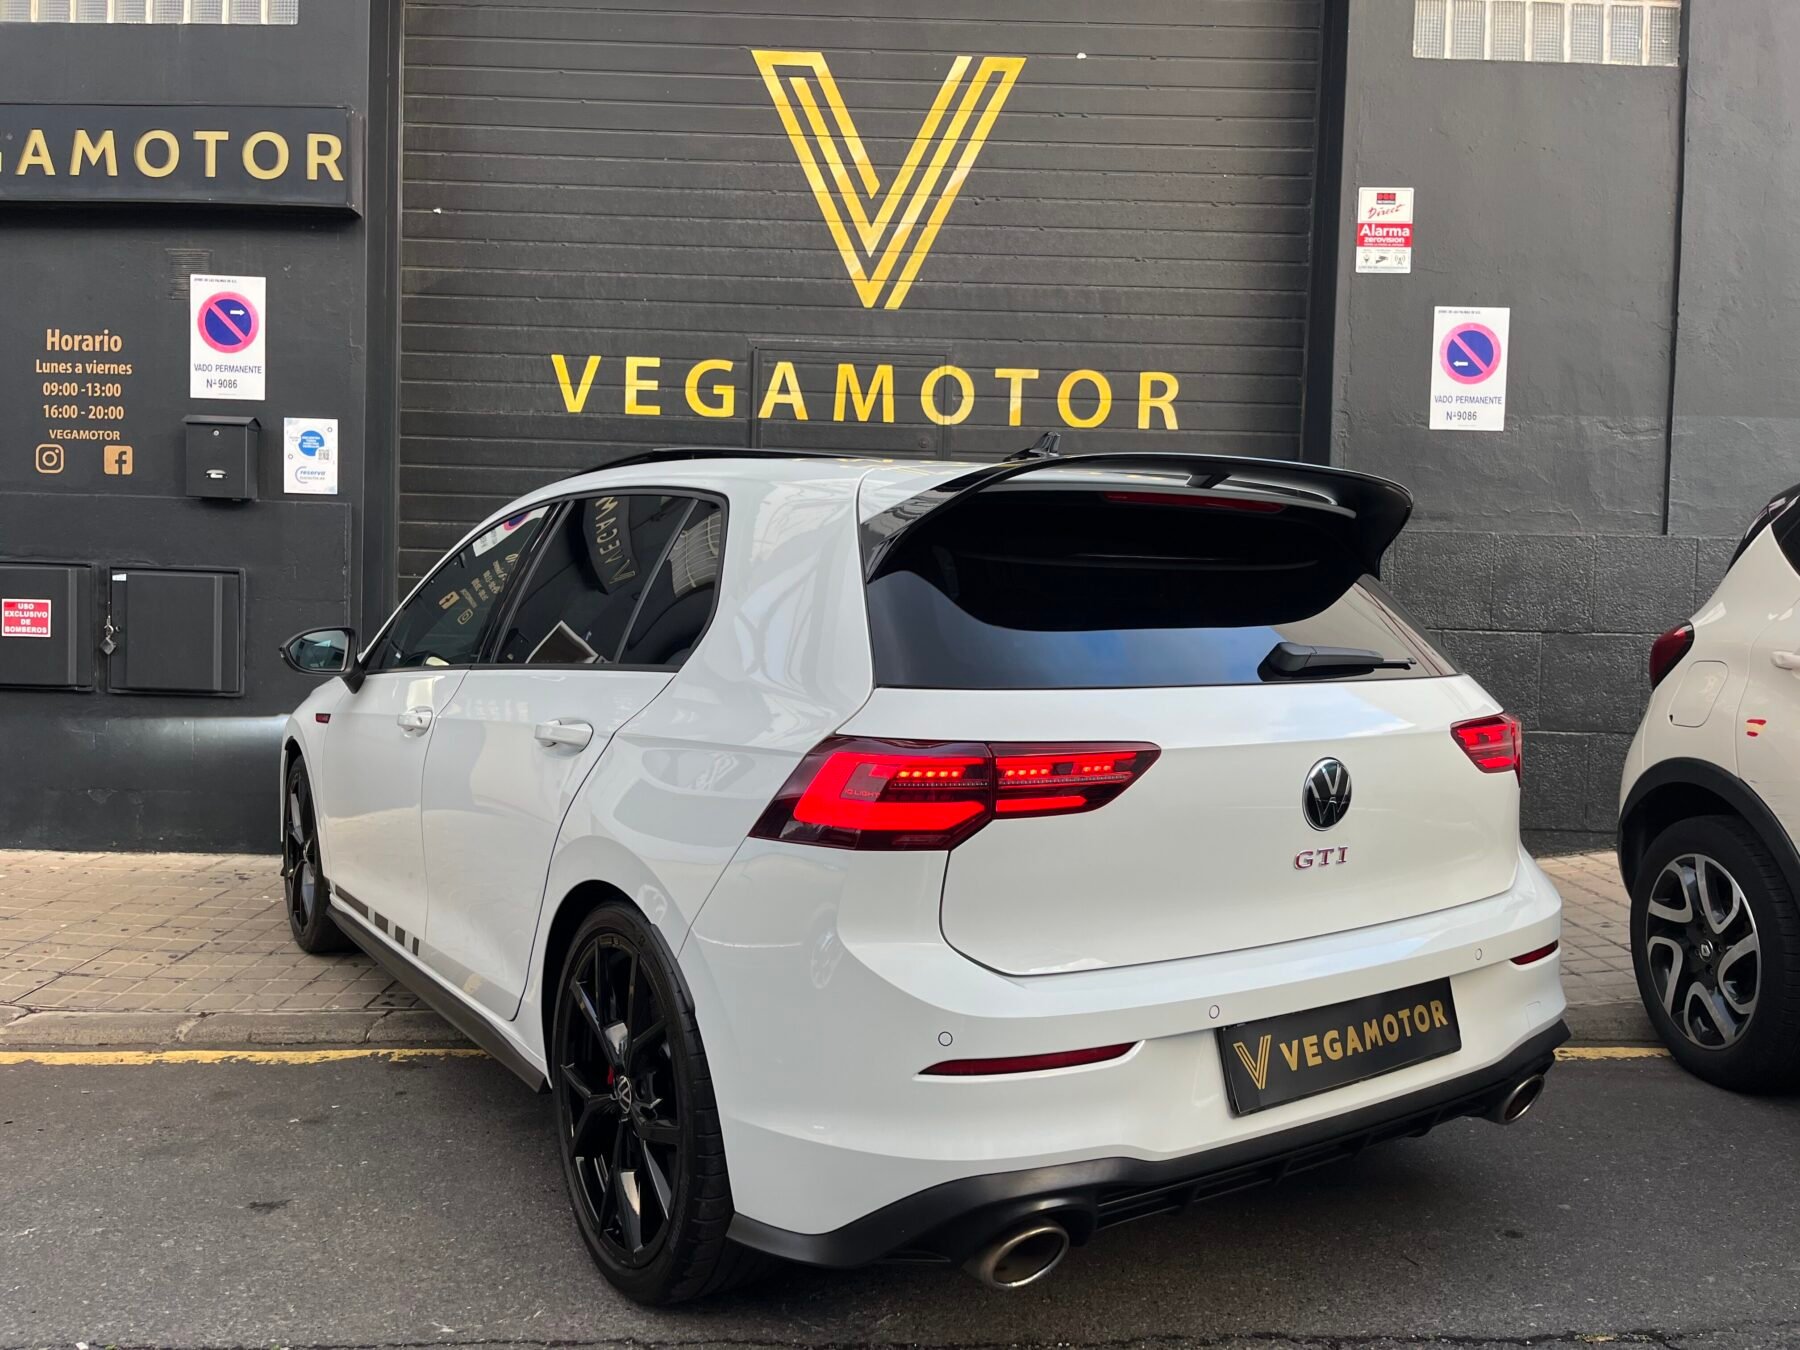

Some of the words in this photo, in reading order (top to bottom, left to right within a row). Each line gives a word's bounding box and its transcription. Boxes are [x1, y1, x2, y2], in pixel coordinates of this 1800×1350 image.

[0, 127, 345, 182] AMOTOR
[1367, 203, 1405, 219] Direct
[1360, 224, 1410, 237] Alarma
[1364, 236, 1405, 244] zerovision
[46, 328, 123, 352] Horario
[36, 359, 72, 374] Lunes
[75, 363, 83, 374] a
[85, 360, 132, 375] viernes
[194, 363, 213, 372] VADO
[215, 364, 262, 374] PERMANENTE
[43, 382, 78, 396] 09:00
[551, 352, 1181, 431] VEGAMOTOR
[1434, 395, 1453, 404] VADO
[1456, 395, 1503, 405] PERMANENTE
[43, 405, 78, 419] 16:00
[88, 405, 124, 420] 20:00
[49, 429, 121, 441] VEGAMOTOR
[1293, 845, 1350, 871] GTI
[1279, 999, 1448, 1072] VEGAMOTOR
